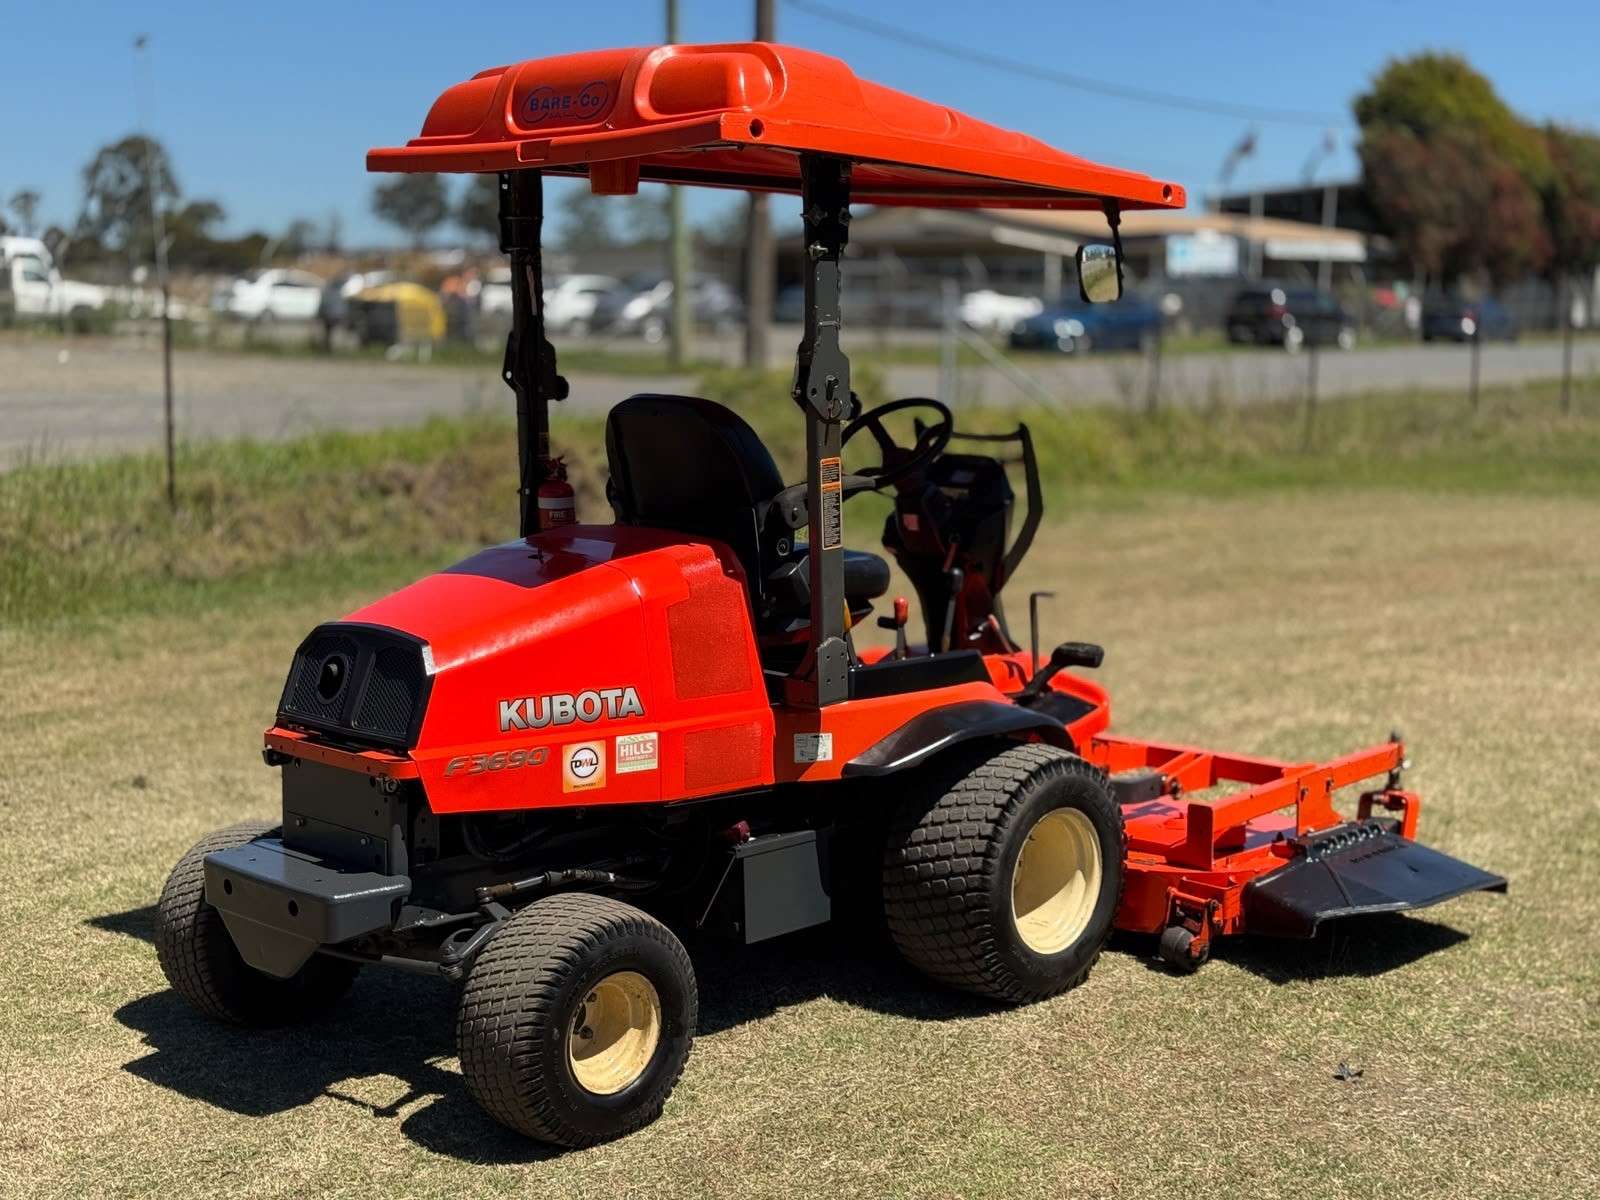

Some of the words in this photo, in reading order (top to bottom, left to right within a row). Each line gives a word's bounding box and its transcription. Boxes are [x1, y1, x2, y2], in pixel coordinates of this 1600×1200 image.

[500, 686, 645, 731] KUBOTA
[445, 746, 550, 777] F3690
[620, 742, 654, 757] HILLS
